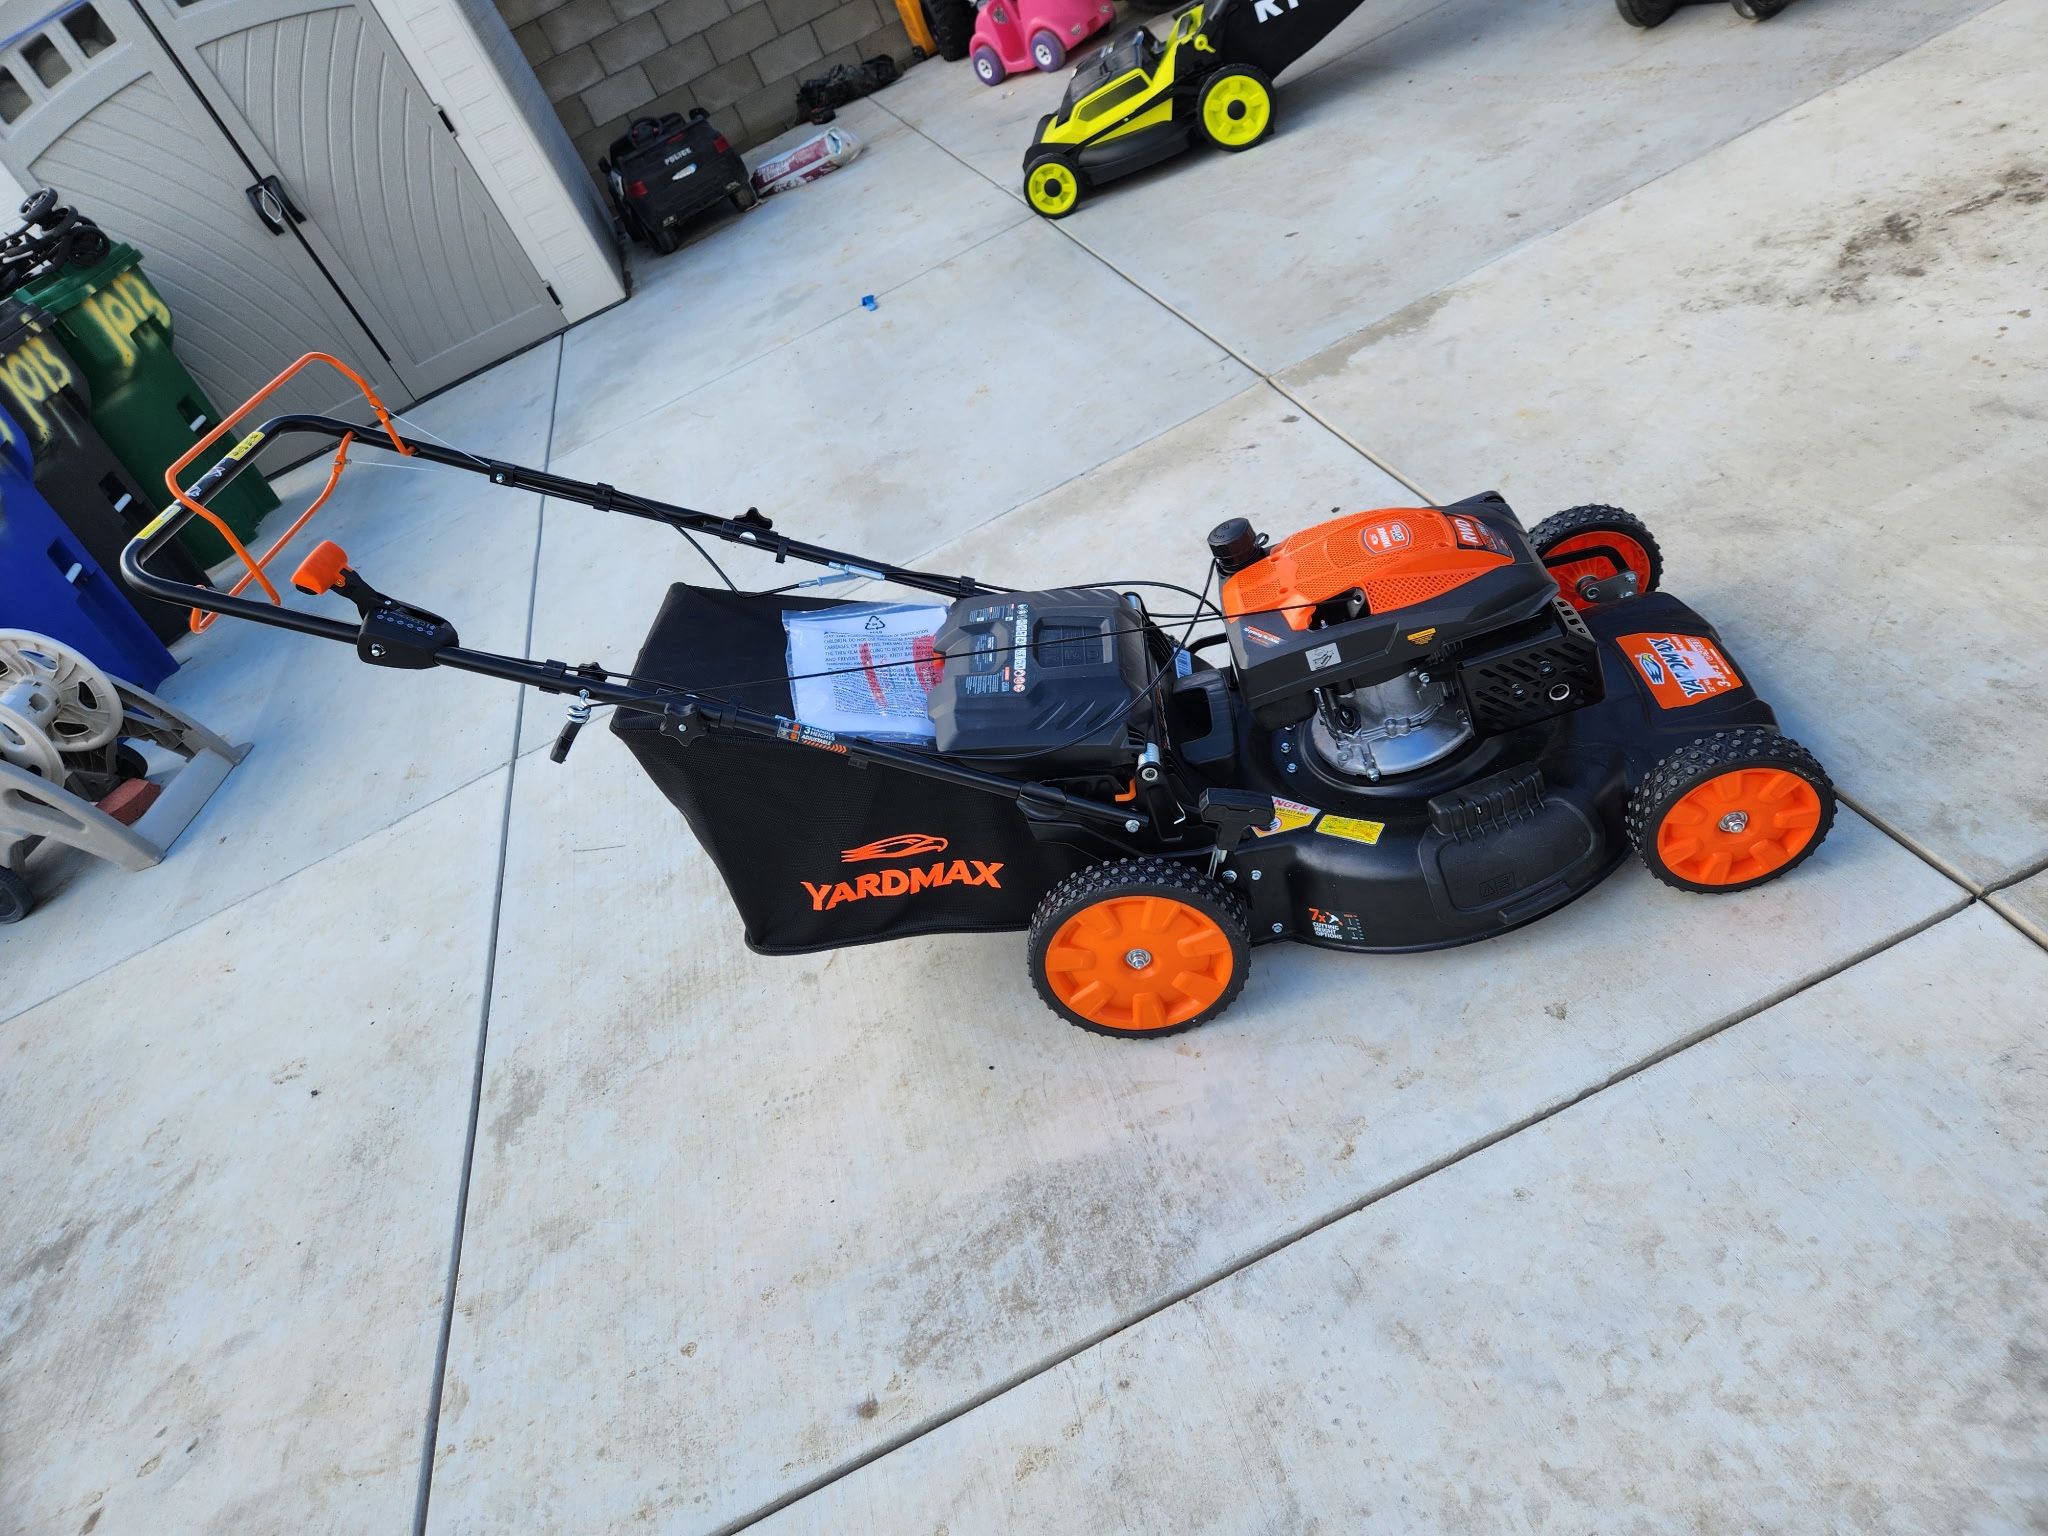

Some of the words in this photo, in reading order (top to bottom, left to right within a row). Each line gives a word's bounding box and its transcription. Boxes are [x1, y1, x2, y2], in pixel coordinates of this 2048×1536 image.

[664, 147, 692, 166] POLICE
[1454, 518, 1479, 544] RWD
[1646, 638, 1707, 697] YADMAX
[1274, 799, 1310, 812] NGER
[800, 860, 1004, 911] YARDMAX
[1313, 922, 1339, 931] CUTTING
[1314, 926, 1336, 935] HEIGHT
[1315, 930, 1342, 940] OPTIONS
